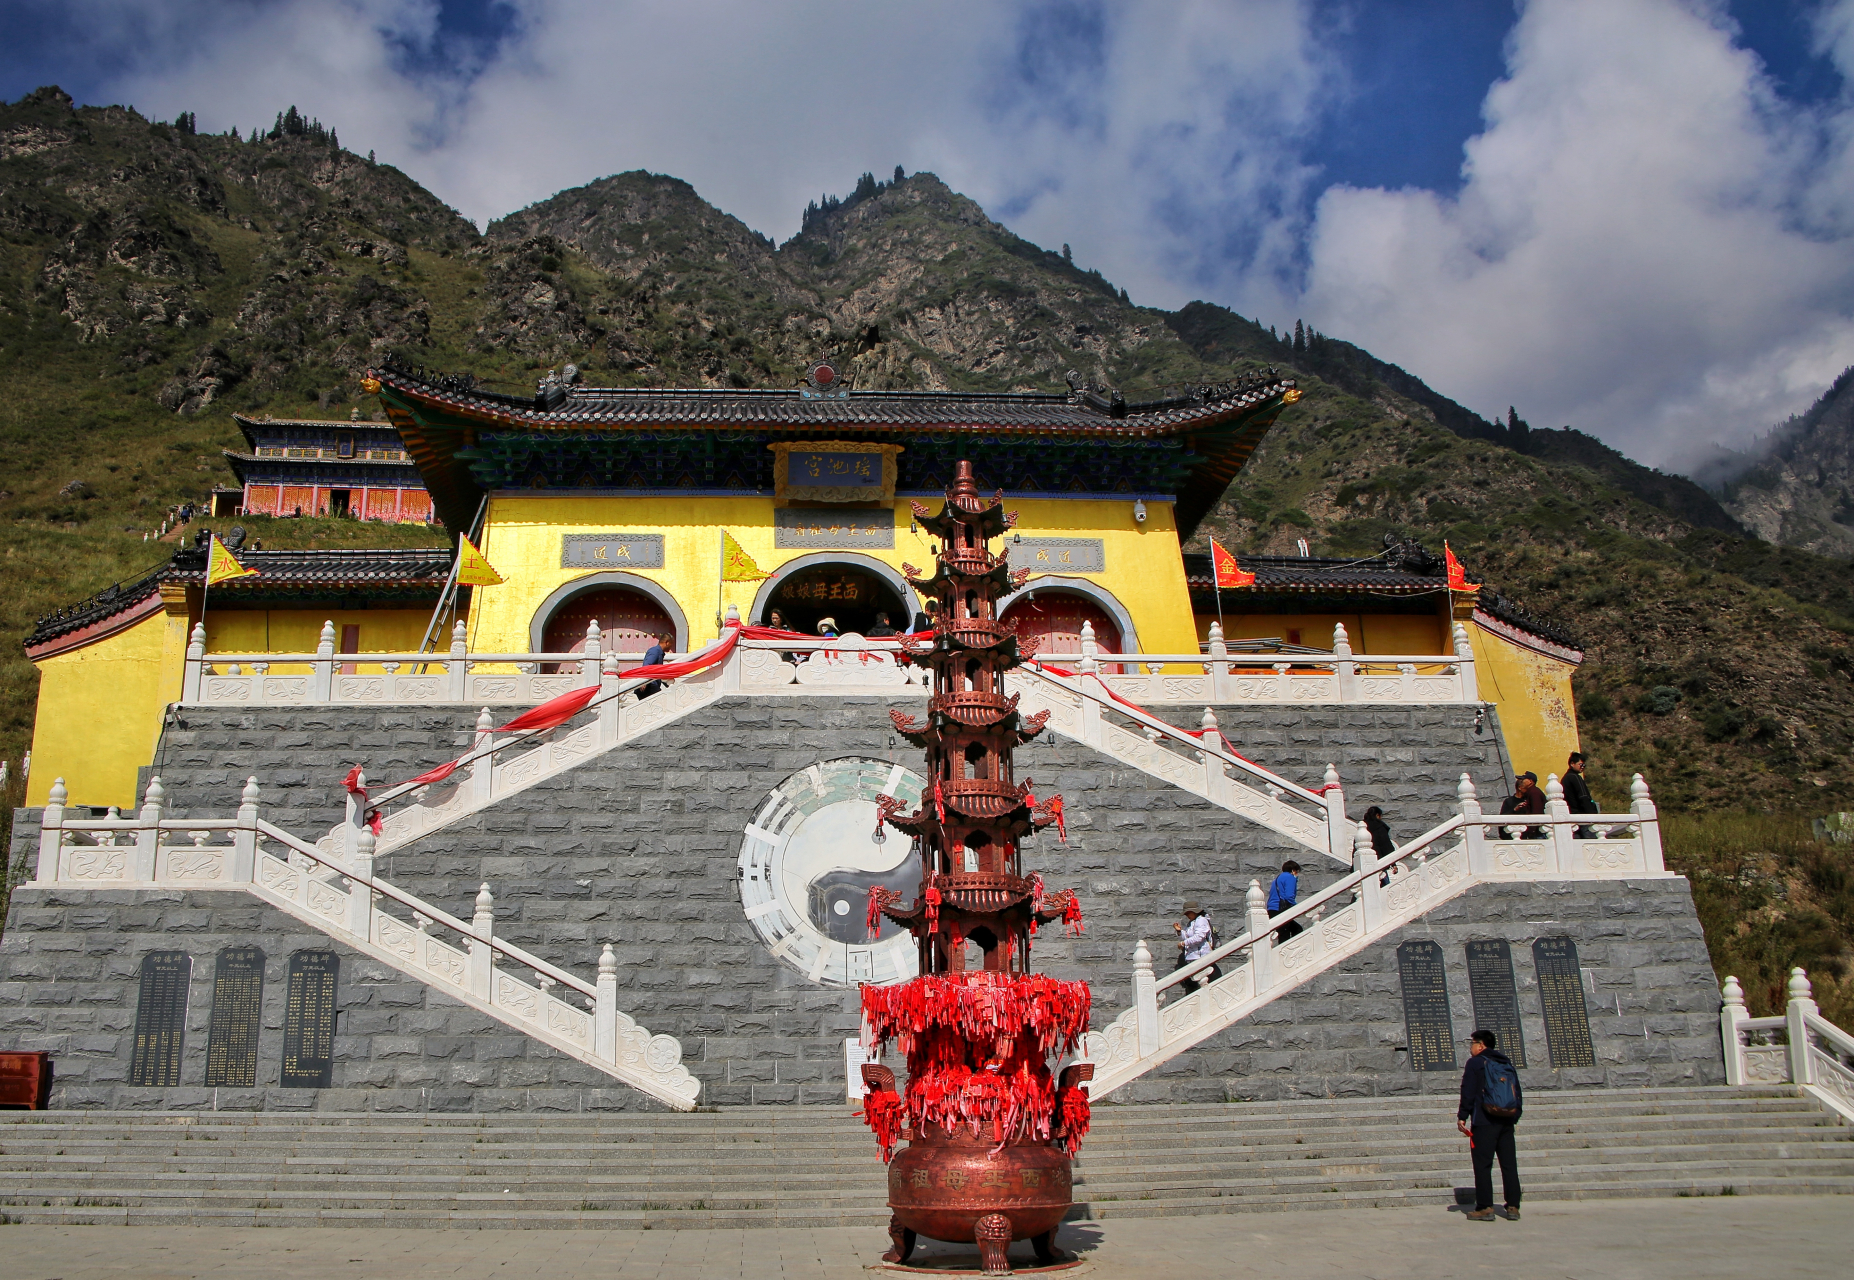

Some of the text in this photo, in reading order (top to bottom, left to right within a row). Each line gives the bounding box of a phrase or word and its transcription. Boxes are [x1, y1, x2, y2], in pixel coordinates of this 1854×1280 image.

[804, 455, 871, 477] 瑶池宫
[215, 557, 233, 572] 水
[463, 554, 480, 569] 土
[729, 552, 745, 567] 火
[1219, 558, 1236, 574] 金
[781, 582, 859, 600] 西王母娘娘
[1405, 945, 1433, 955] 功德碑
[1473, 942, 1501, 952] 功德碑
[1540, 940, 1567, 950] 功德碑
[152, 954, 183, 965] 功德碑
[225, 952, 256, 962] 功德碑
[300, 953, 330, 964] 功德碑
